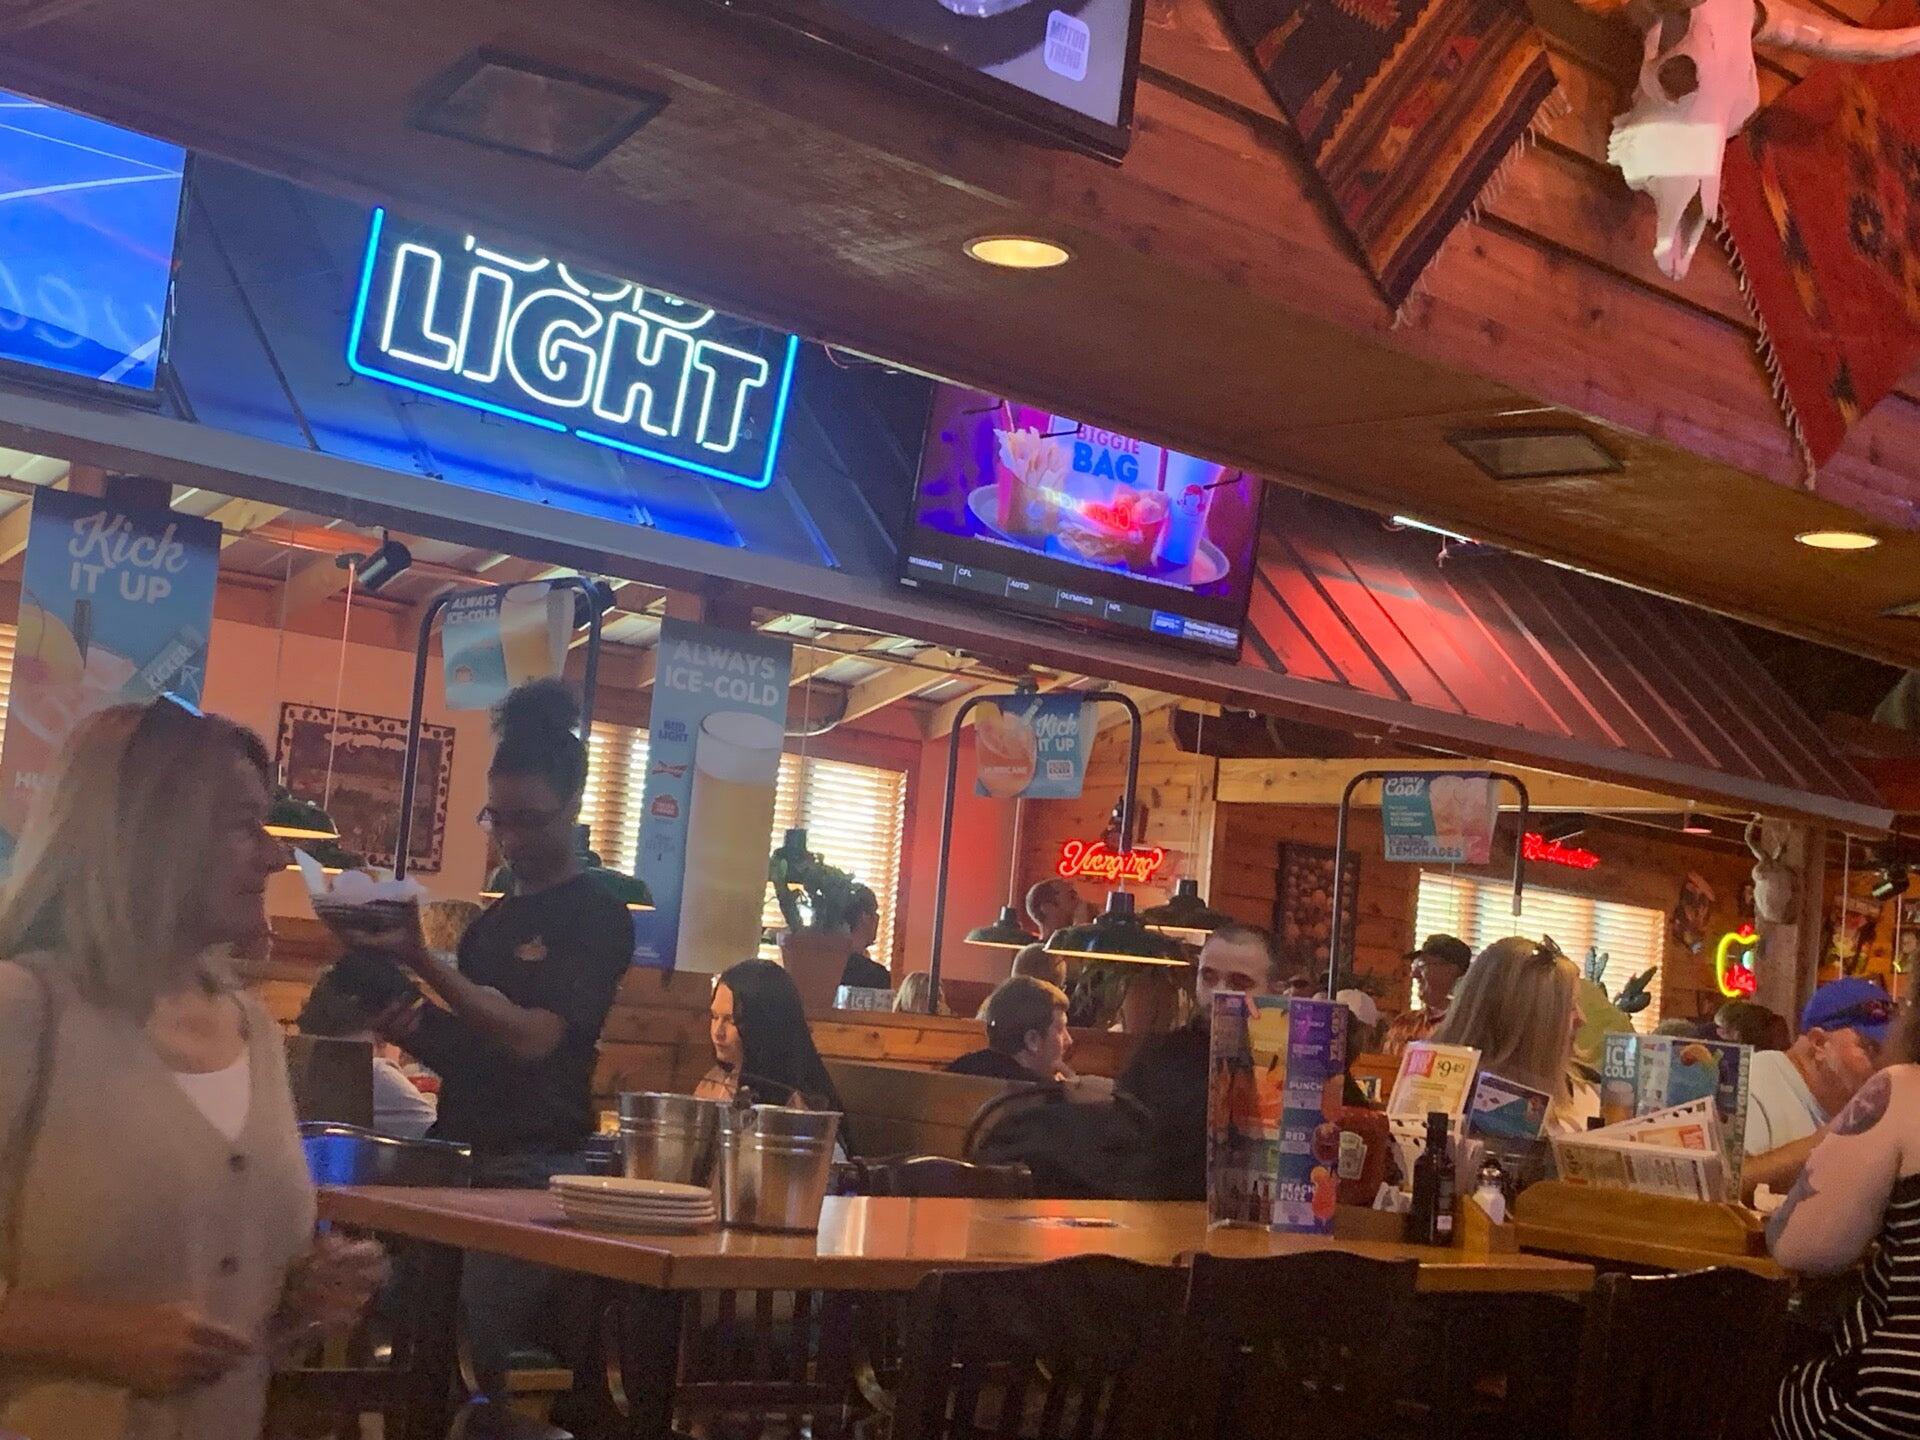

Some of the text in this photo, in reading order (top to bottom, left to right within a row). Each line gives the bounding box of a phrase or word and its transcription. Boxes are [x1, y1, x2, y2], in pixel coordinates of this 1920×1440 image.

[1049, 20, 1087, 52] MOTOR
[1048, 41, 1082, 69] TREND
[380, 242, 769, 453] LIGHT
[1077, 425, 1140, 455] BIGGIE
[1073, 441, 1138, 483] BAG
[68, 511, 188, 573] Kick
[70, 561, 171, 604] IT UP
[958, 568, 973, 577] CFL
[451, 594, 497, 609] ALWAYS
[447, 609, 497, 625] ICE-COLD
[674, 639, 775, 680] ALWAYS
[664, 664, 779, 706] ICE-COLD
[663, 719, 686, 731] BUD
[1036, 713, 1077, 739] Kick
[658, 729, 689, 743] LIGHT
[1038, 738, 1075, 752] IT UP
[1385, 777, 1426, 797] Cool
[1388, 846, 1463, 858] LEMONADES
[1606, 1045, 1635, 1067] ICE
[1604, 1065, 1634, 1079] COLD
[1288, 1081, 1323, 1091] PUNCH
[1285, 1131, 1306, 1141] RED
[1280, 1183, 1316, 1193] PEACH
